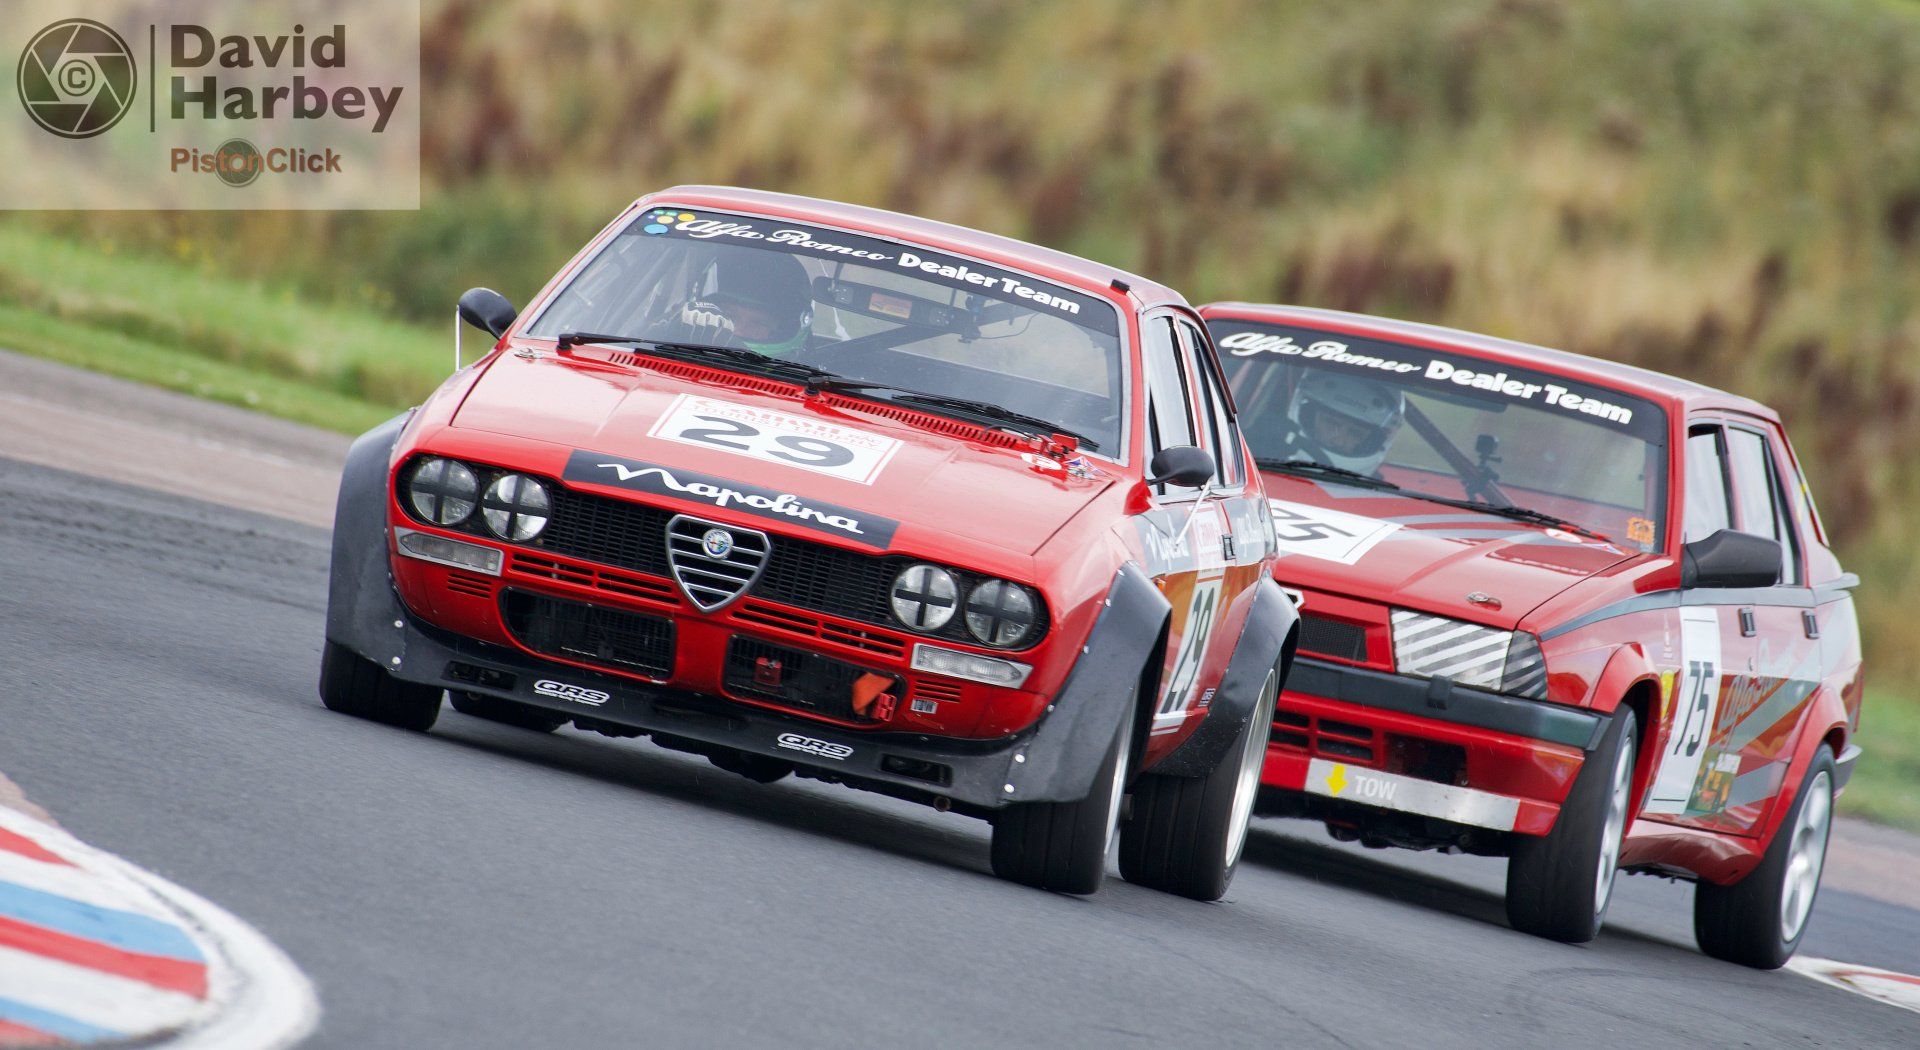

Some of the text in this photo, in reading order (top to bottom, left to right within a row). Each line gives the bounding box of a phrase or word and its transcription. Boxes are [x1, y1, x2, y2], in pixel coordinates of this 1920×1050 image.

[674, 218, 1081, 315] Alfa Romeo Dealer Team
[1219, 332, 1633, 425] Alfa Romeo Dealer Team
[679, 415, 855, 467] 29
[595, 463, 865, 535] Napolina
[1159, 586, 1216, 714] 29
[1673, 660, 1714, 757] 75
[1354, 775, 1398, 801] TOW
